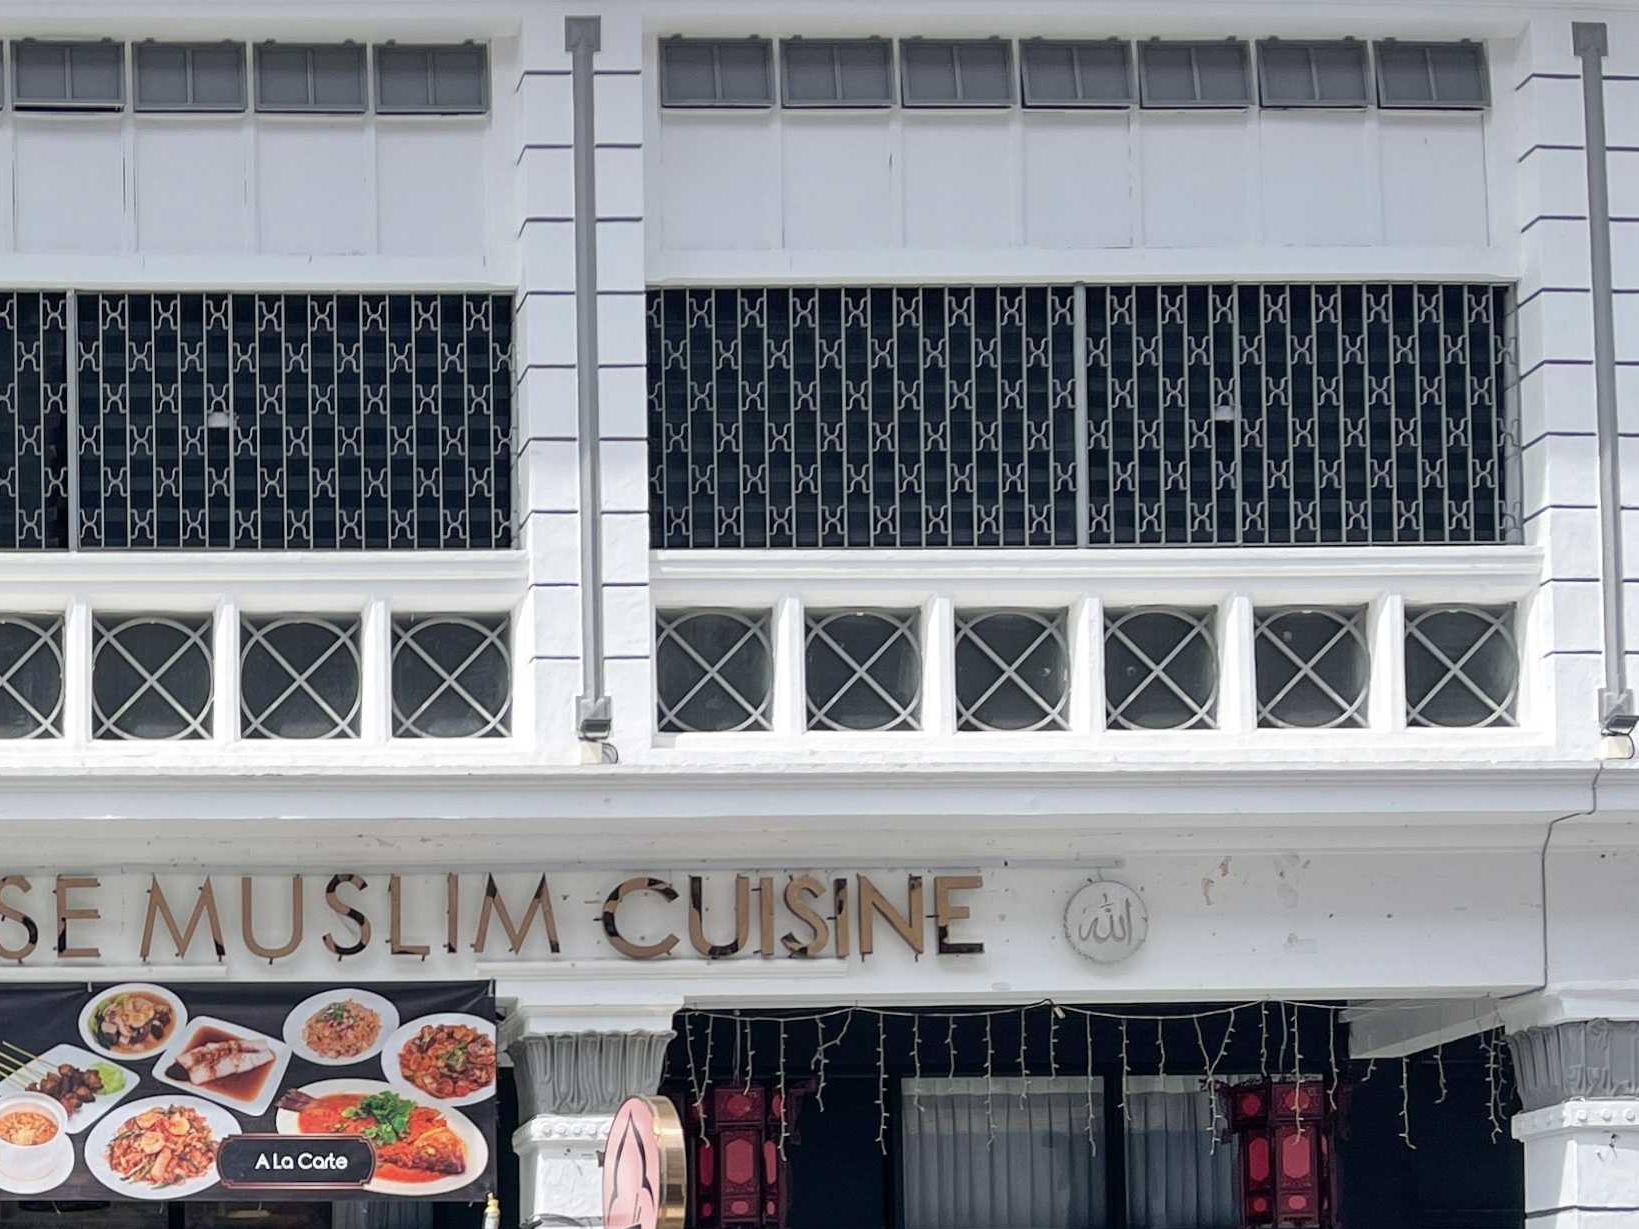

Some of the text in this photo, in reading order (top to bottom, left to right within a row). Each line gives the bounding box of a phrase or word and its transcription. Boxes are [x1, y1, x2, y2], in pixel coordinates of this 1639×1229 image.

[139, 872, 561, 959] MUSLIM
[601, 874, 985, 960] CUISINE
[254, 1152, 349, 1170] A La Carte
